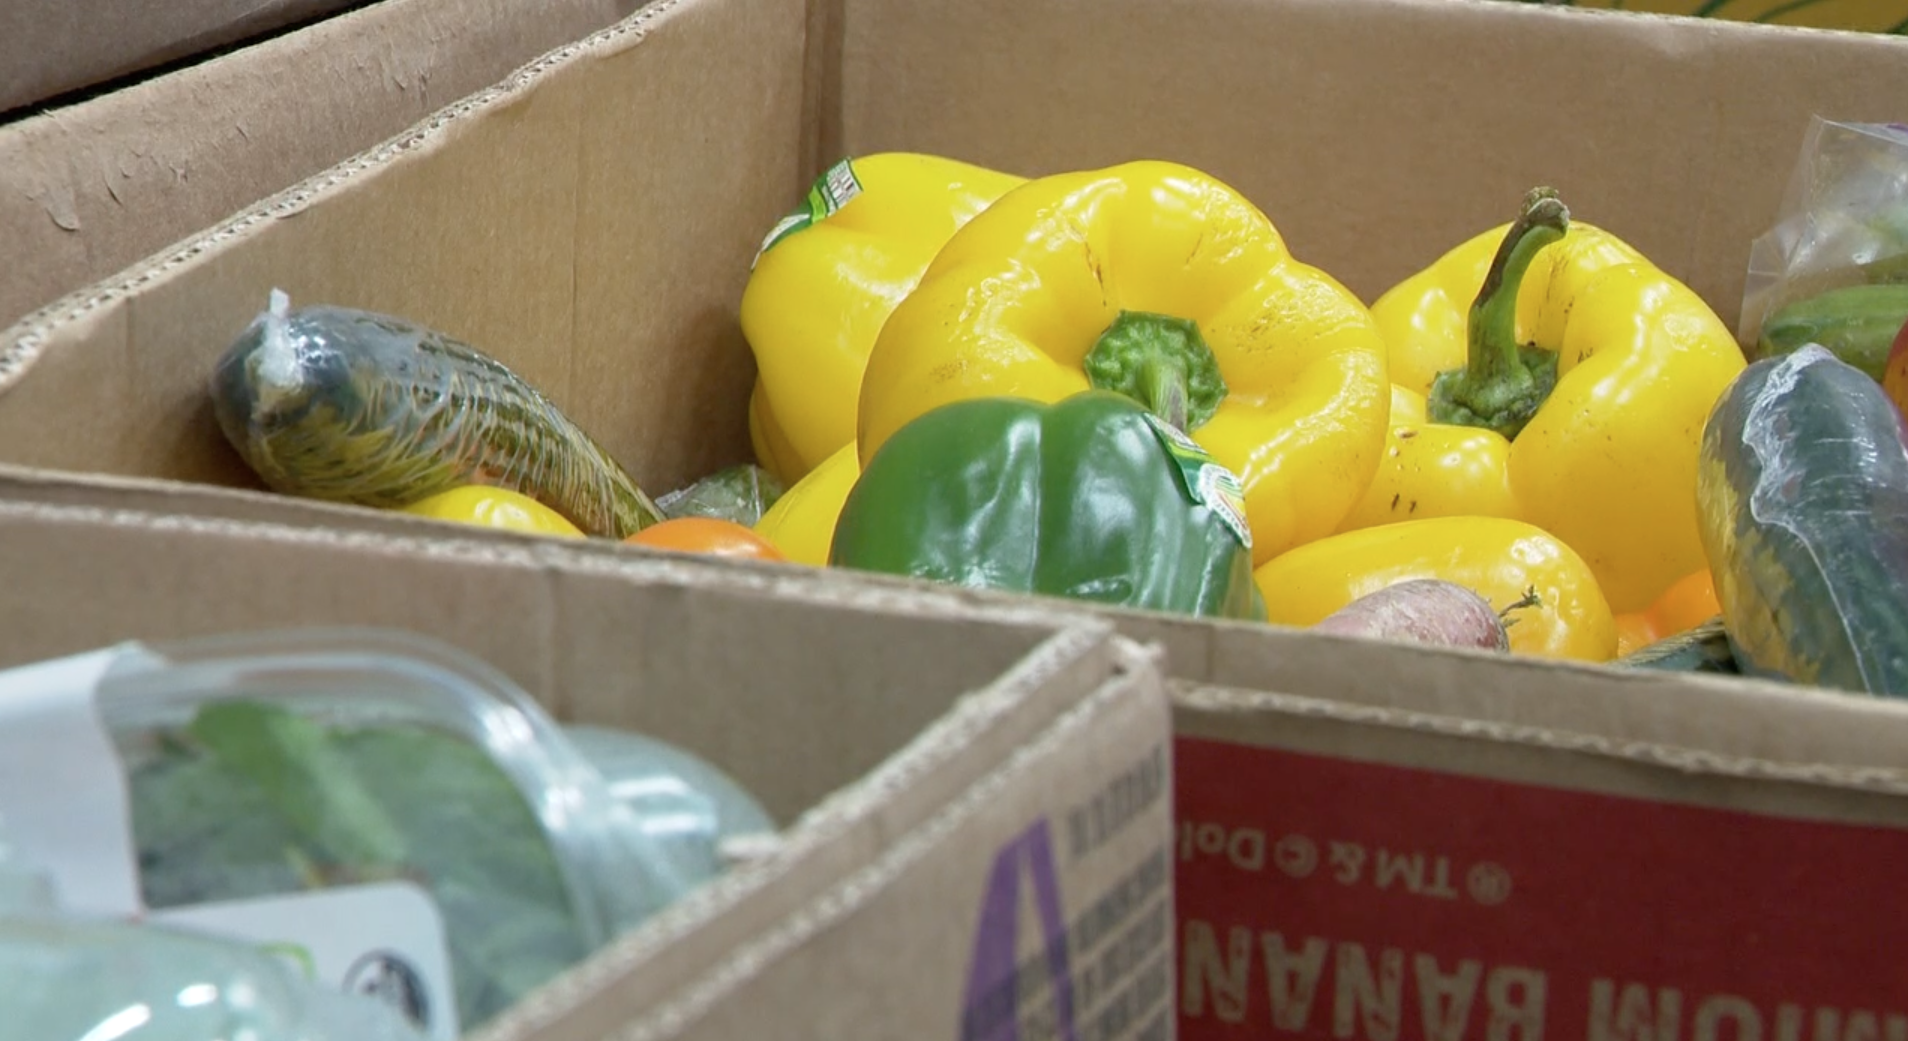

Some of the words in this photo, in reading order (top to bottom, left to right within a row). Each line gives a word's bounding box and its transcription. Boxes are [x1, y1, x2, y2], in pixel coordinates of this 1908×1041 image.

[1177, 820, 1267, 872] Dol
[1328, 840, 1367, 886] &
[1373, 848, 1459, 899] TM
